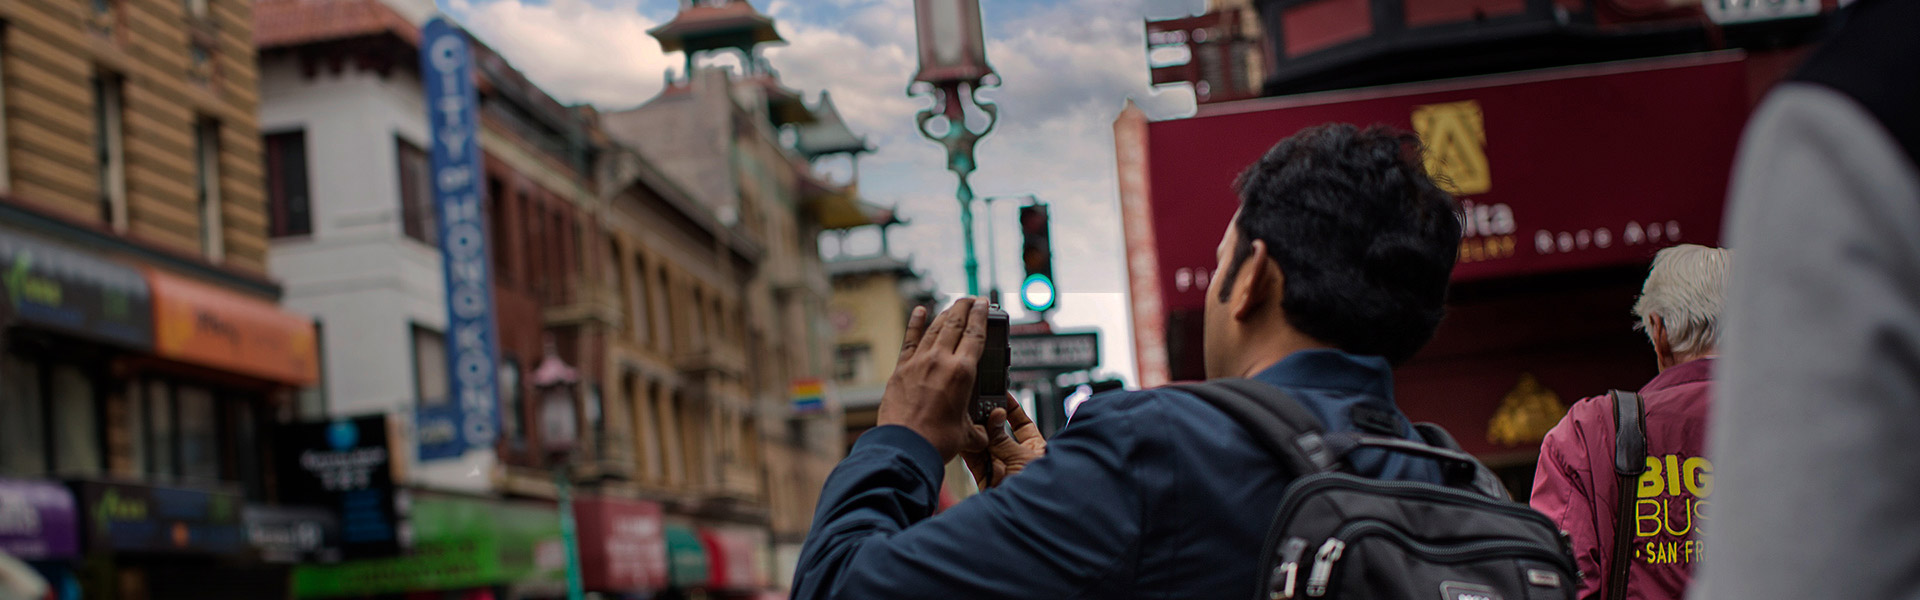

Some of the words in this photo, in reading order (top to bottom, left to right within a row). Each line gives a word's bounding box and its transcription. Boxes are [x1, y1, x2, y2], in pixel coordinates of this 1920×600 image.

[430, 34, 467, 161] CITY
[1461, 199, 1517, 237] ita
[1623, 220, 1682, 247] Art
[445, 196, 485, 319] HONG
[455, 326, 495, 445] KONG
[1638, 454, 1715, 498] BIG
[1636, 498, 1713, 537] BUS
[1646, 541, 1677, 564] SAN
[1685, 540, 1709, 563] FR
